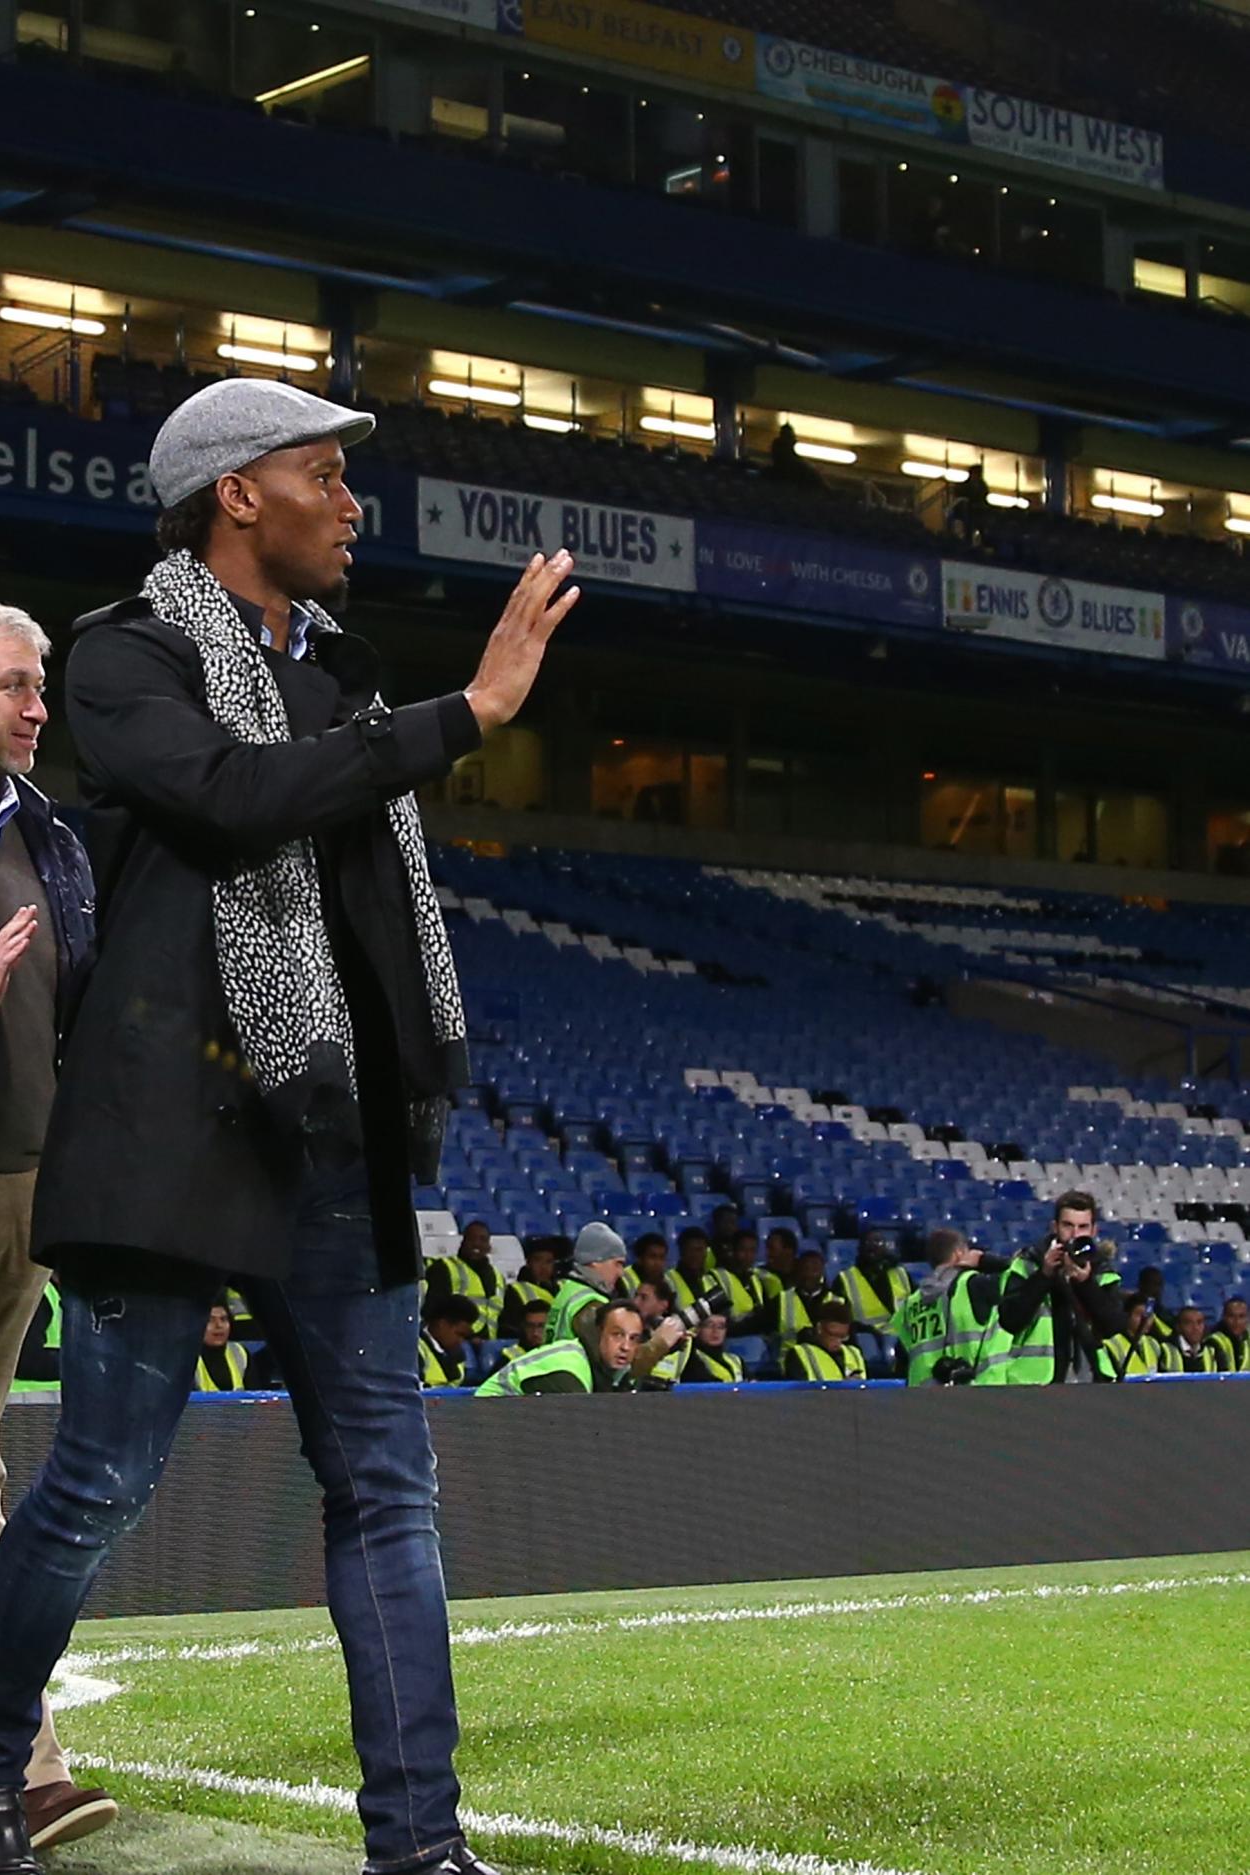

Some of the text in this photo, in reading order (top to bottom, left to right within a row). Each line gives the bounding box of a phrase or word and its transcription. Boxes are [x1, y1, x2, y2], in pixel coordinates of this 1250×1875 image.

[602, 14, 703, 56] BELFAST
[972, 88, 1073, 147] SOUTH
[1085, 117, 1159, 167] WEST
[457, 488, 658, 565] YORK BLUES
[726, 552, 763, 573] LOVE
[791, 561, 830, 582] WITH
[832, 567, 893, 592] CHELSEA
[976, 583, 1030, 619] ENNIS
[1081, 601, 1136, 635] BLUES
